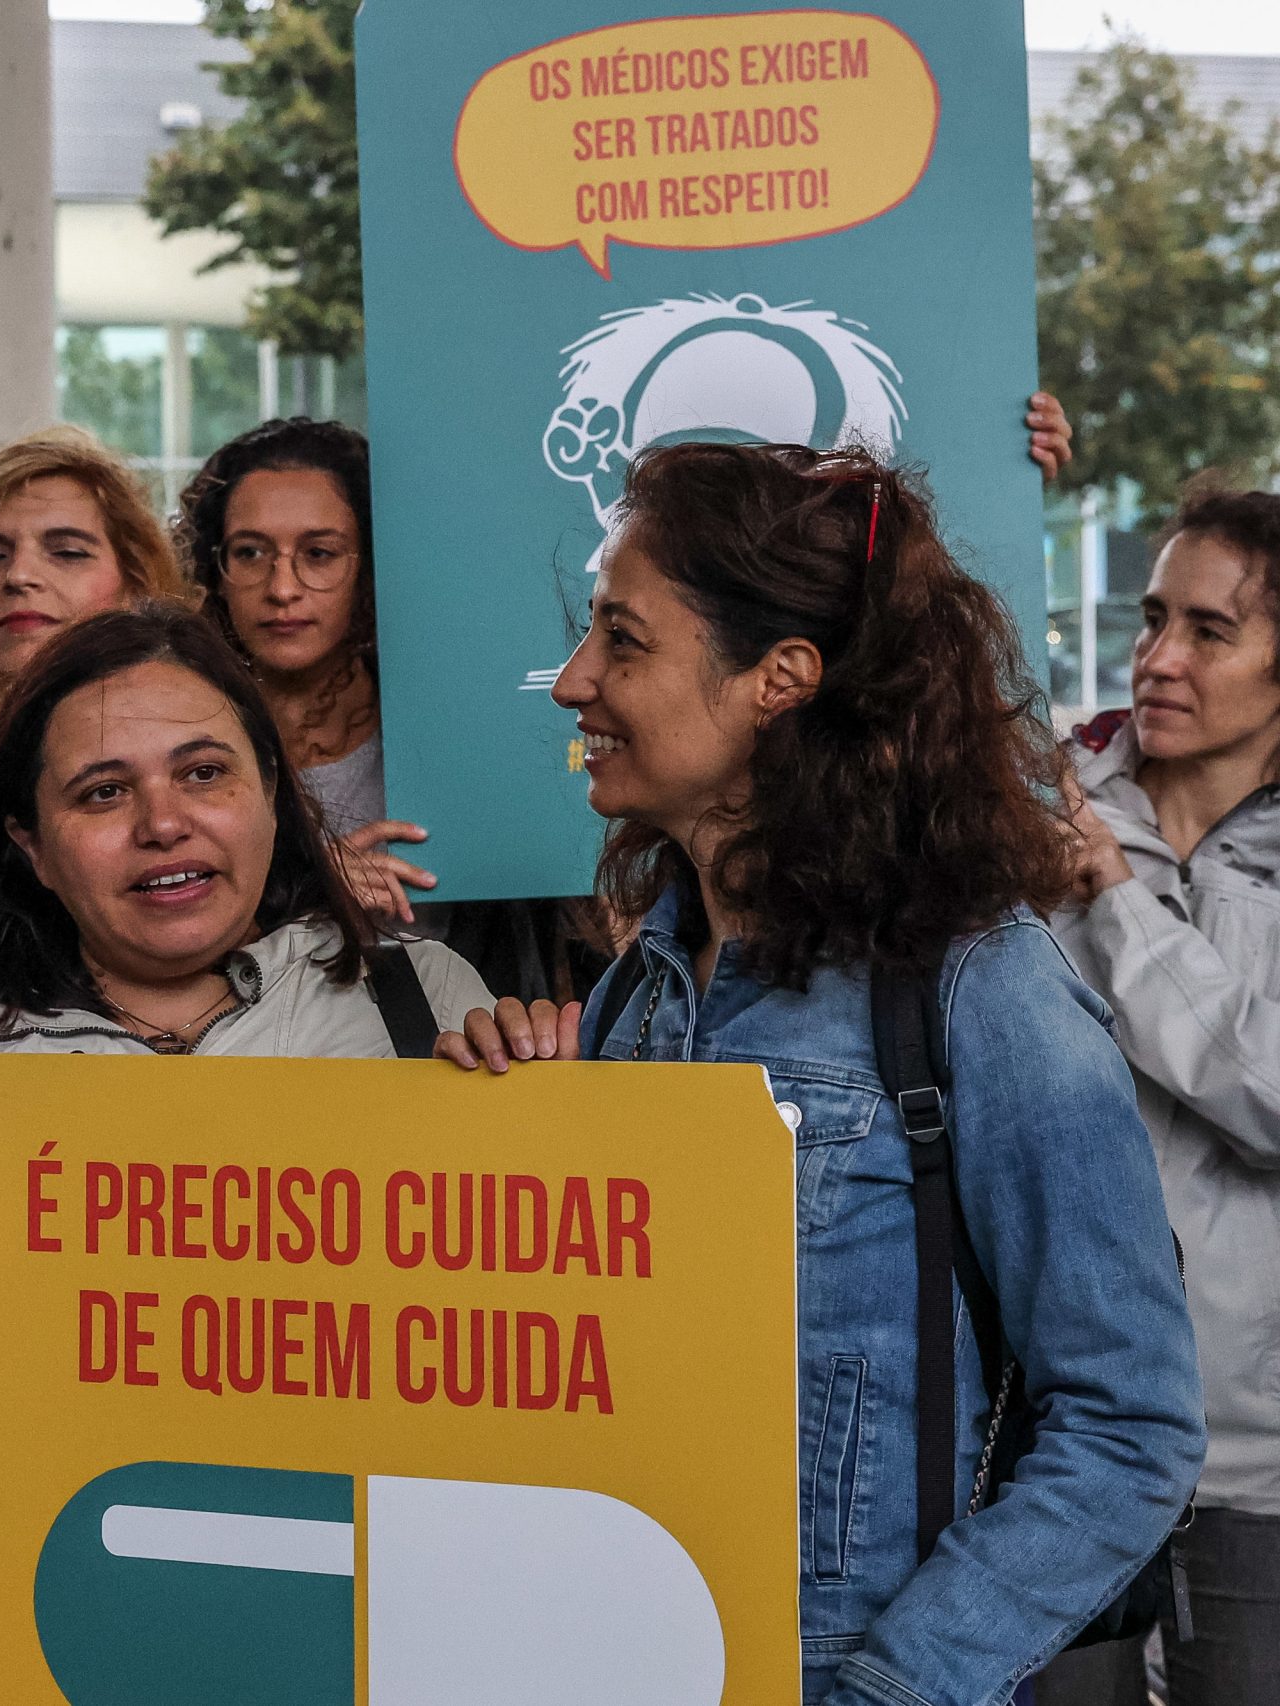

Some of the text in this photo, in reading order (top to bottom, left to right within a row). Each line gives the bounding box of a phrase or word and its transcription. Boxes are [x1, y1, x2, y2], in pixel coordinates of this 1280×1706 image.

[529, 37, 869, 102] OS MÉDICOS EXIGEM
[572, 104, 819, 162] SER TRATADOS
[575, 167, 830, 225] COM RESPEITO!
[27, 1140, 653, 1279] É PRECISO CUIDAR
[78, 1289, 615, 1415] DE QUEM CUIDA
